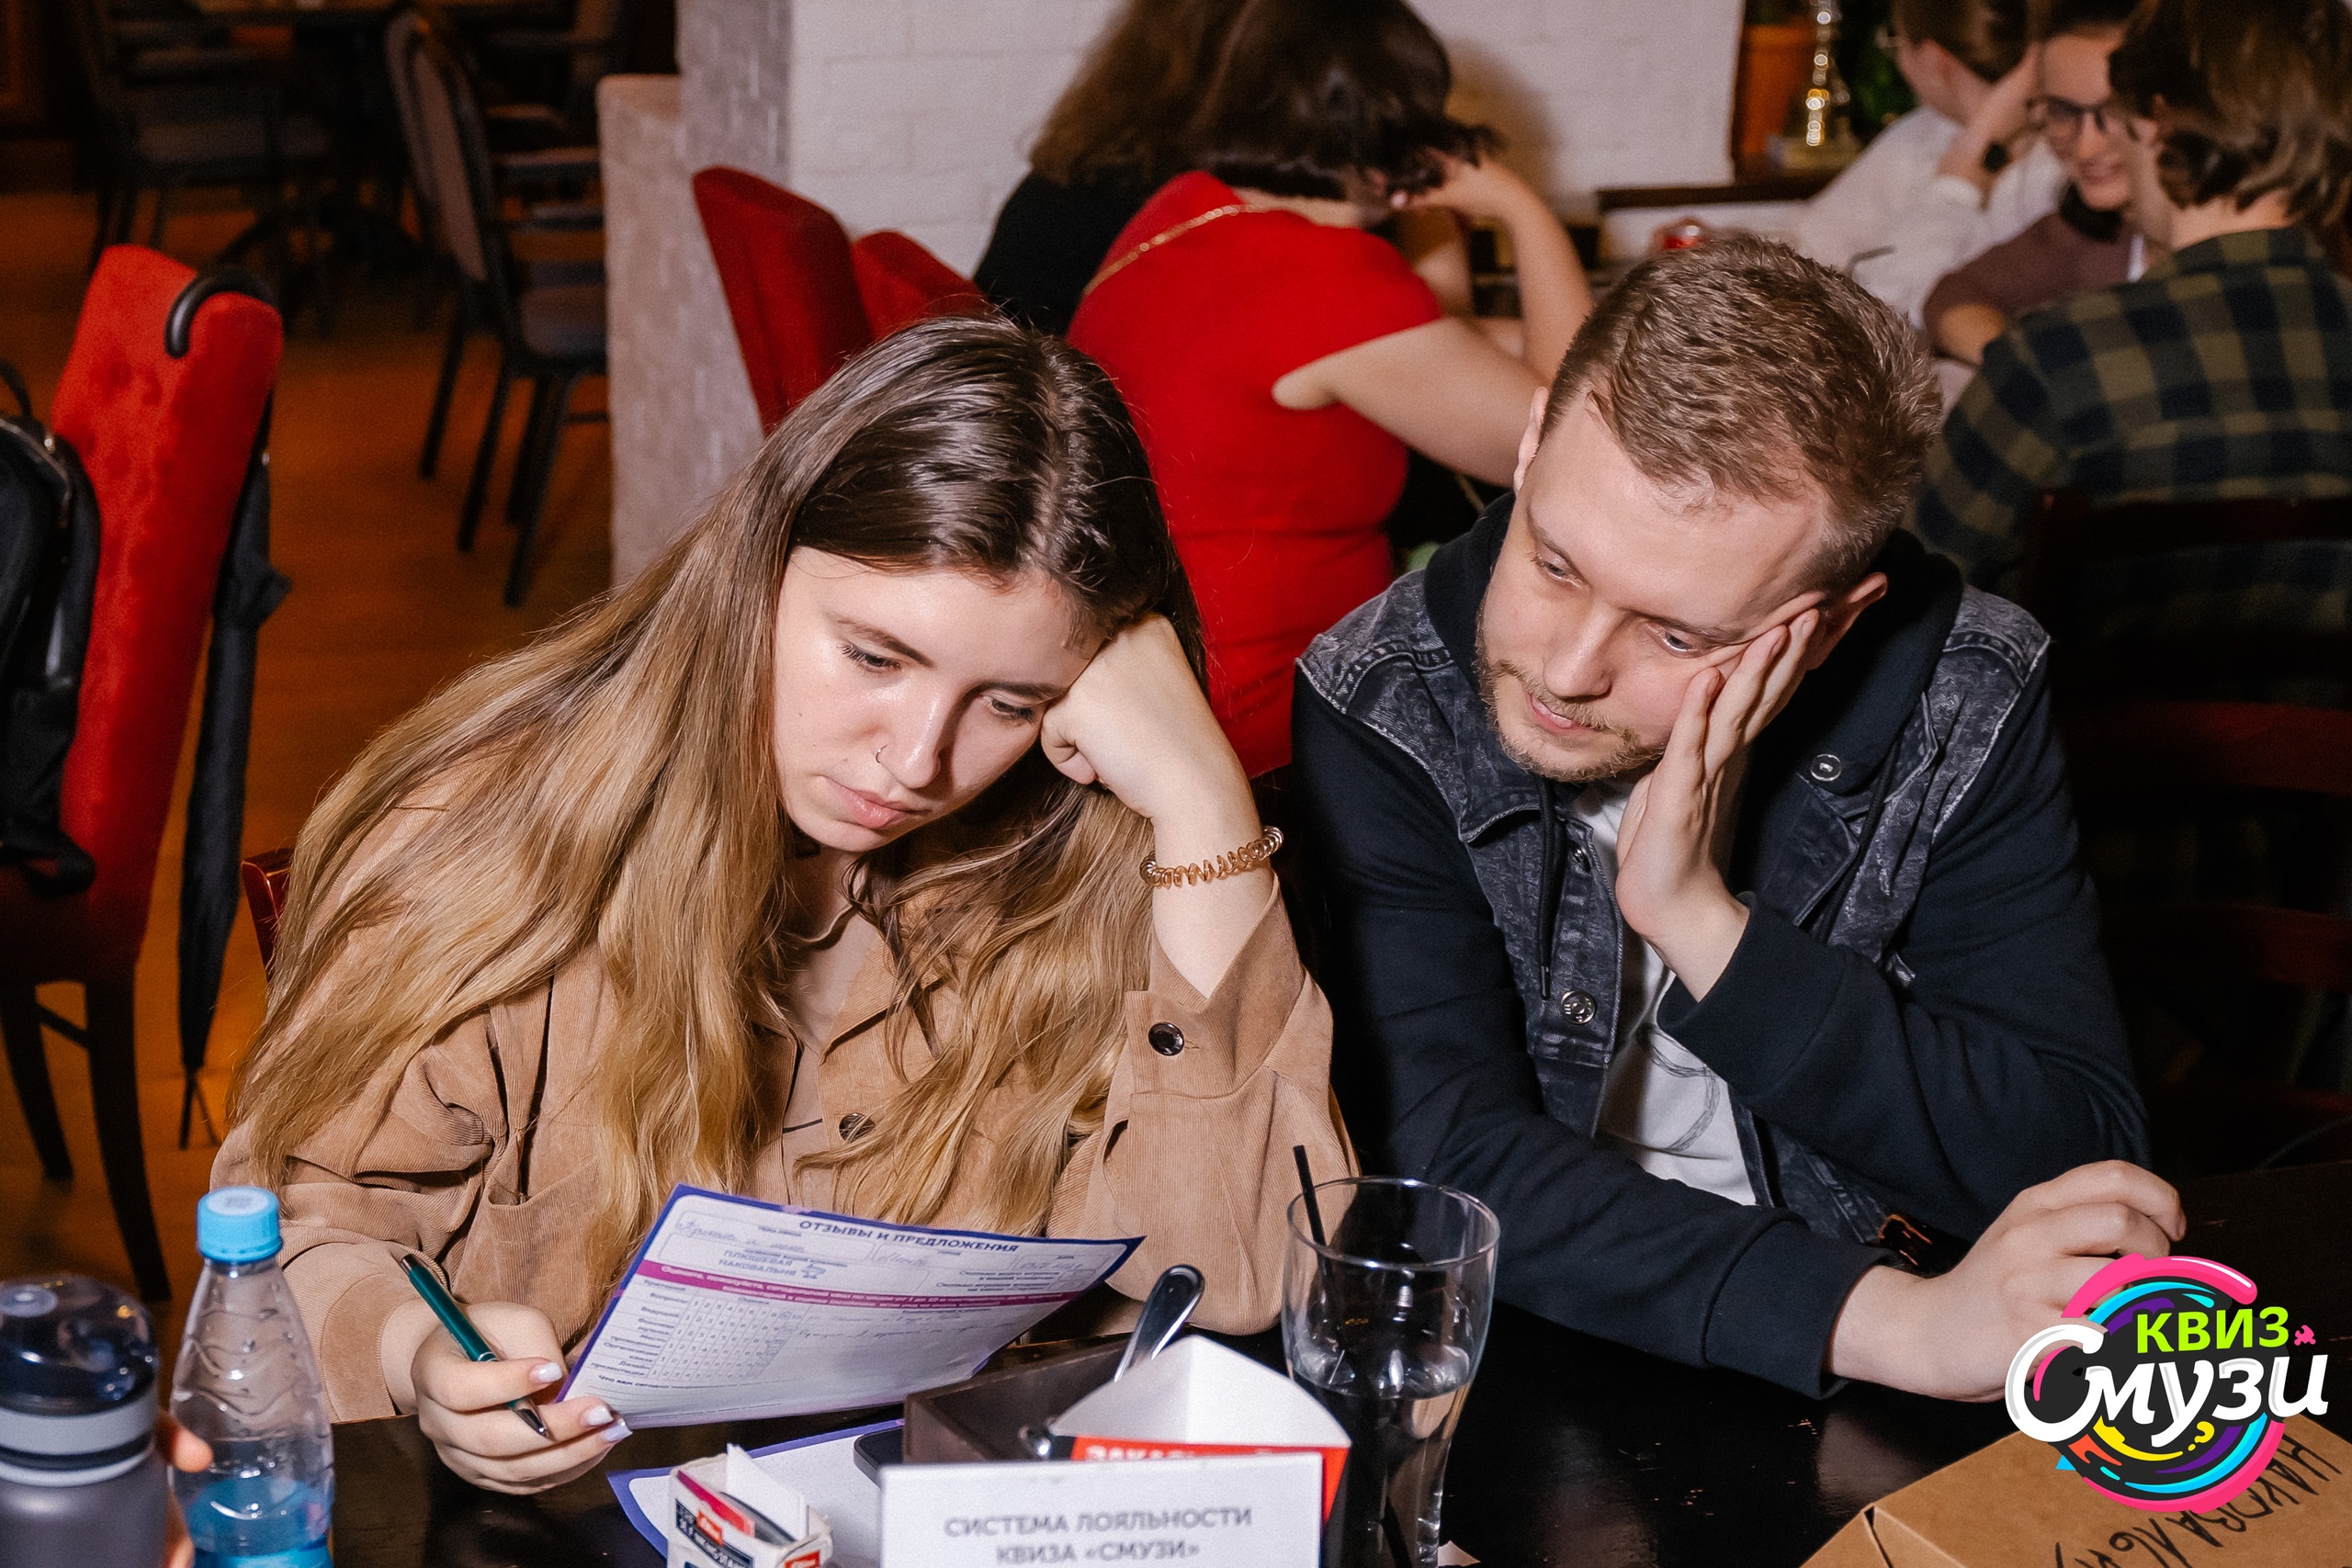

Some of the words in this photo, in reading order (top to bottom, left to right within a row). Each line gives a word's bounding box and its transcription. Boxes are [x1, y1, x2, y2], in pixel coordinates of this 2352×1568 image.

[799, 1222, 872, 1239] ОТЗЫВЫ
[876, 1231, 889, 1240] И
[891, 1234, 1020, 1253] ПРЕДЛОЖЕНИЯ
[944, 1514, 1069, 1538] СИСТЕМА
[1077, 1507, 1252, 1533] ЛОЯЛЬНОСТИ
[995, 1544, 1077, 1565] КВИЗА
[1085, 1540, 1201, 1562] «СМУЗИ»
